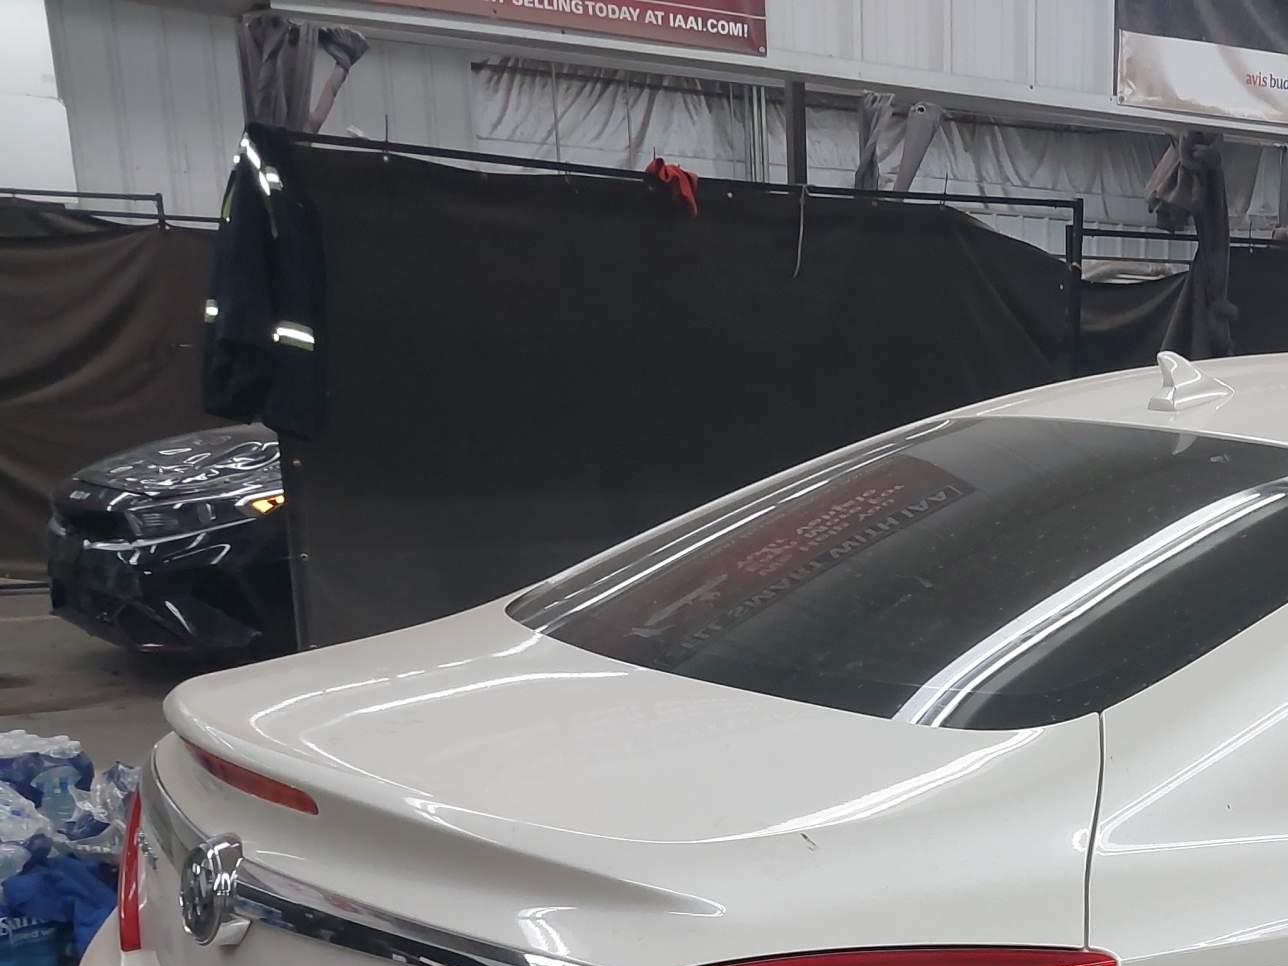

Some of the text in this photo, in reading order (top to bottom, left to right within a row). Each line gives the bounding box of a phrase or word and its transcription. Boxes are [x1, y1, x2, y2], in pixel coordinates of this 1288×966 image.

[584, 2, 640, 21] TODAY
[645, 10, 664, 25] AT
[669, 13, 748, 38] IAAI.COM!
[1245, 72, 1268, 88] avis
